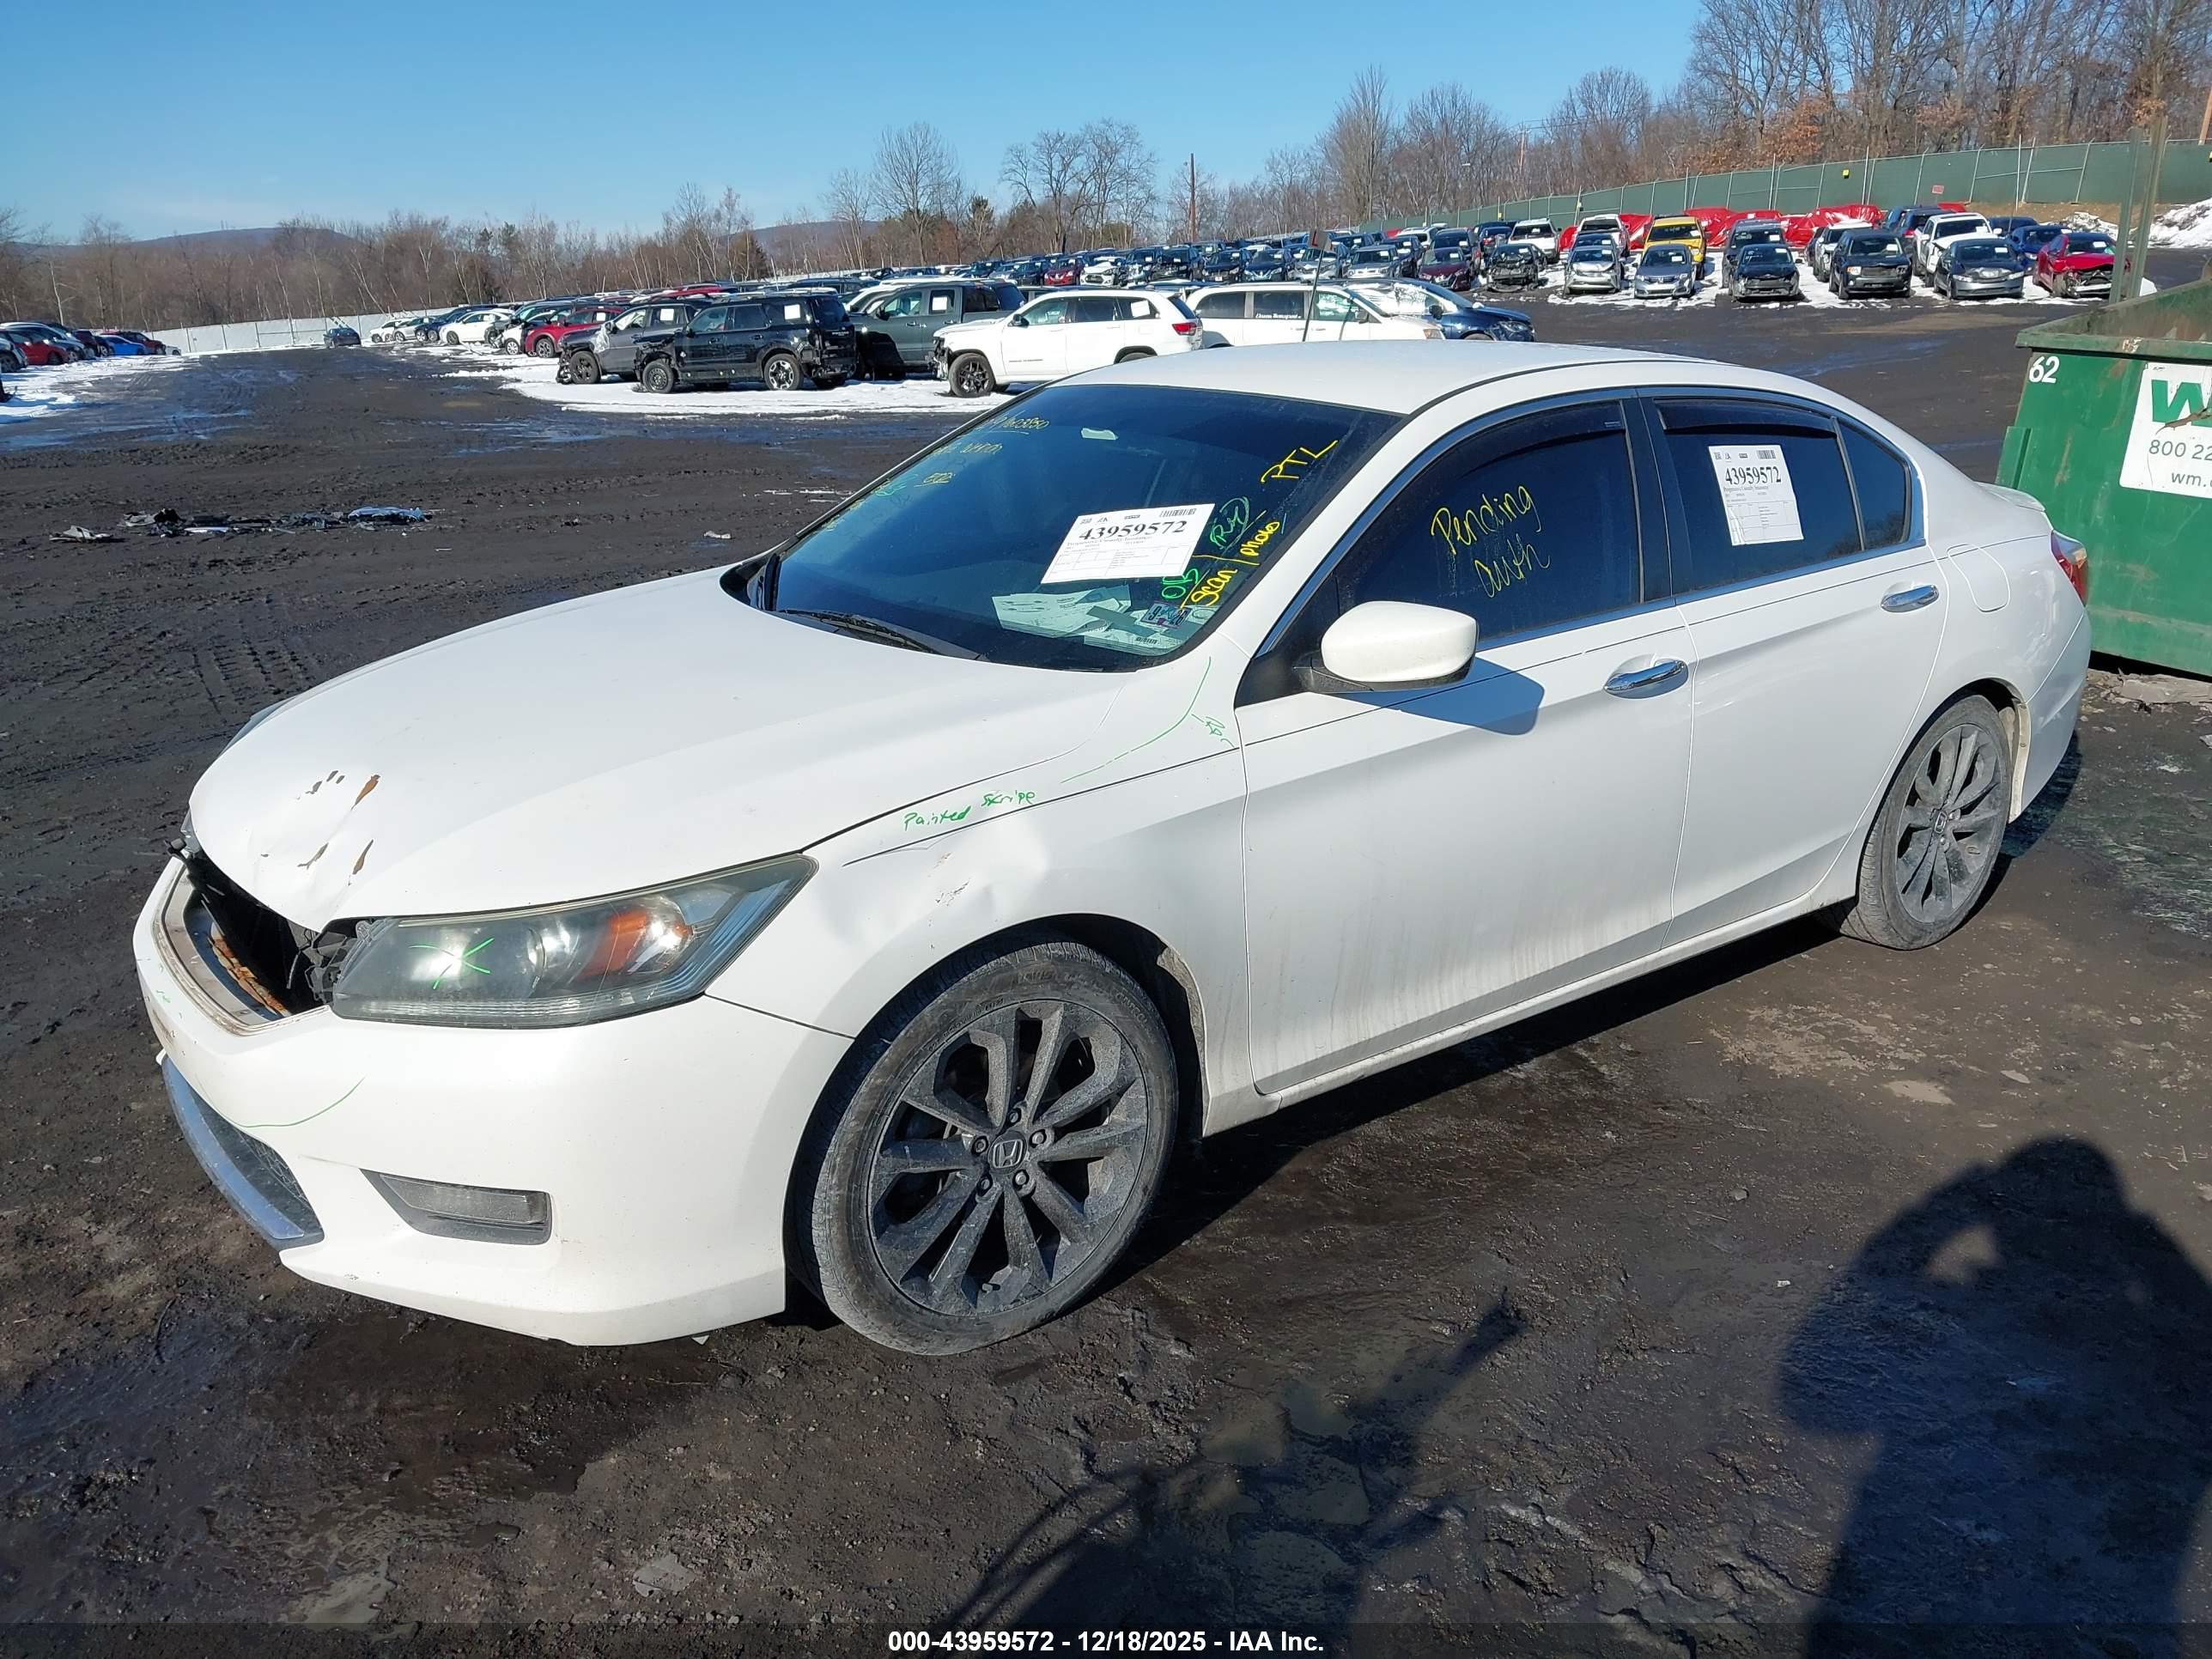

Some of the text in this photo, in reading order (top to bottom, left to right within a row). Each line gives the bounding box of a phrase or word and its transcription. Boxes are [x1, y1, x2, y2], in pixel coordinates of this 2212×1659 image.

[2028, 356, 2060, 384] 62
[2151, 379, 2212, 428] W
[2148, 439, 2186, 458] 800
[1725, 465, 1782, 485] 43959572
[1079, 520, 1188, 541] 43959572
[1431, 485, 1542, 555] Pending
